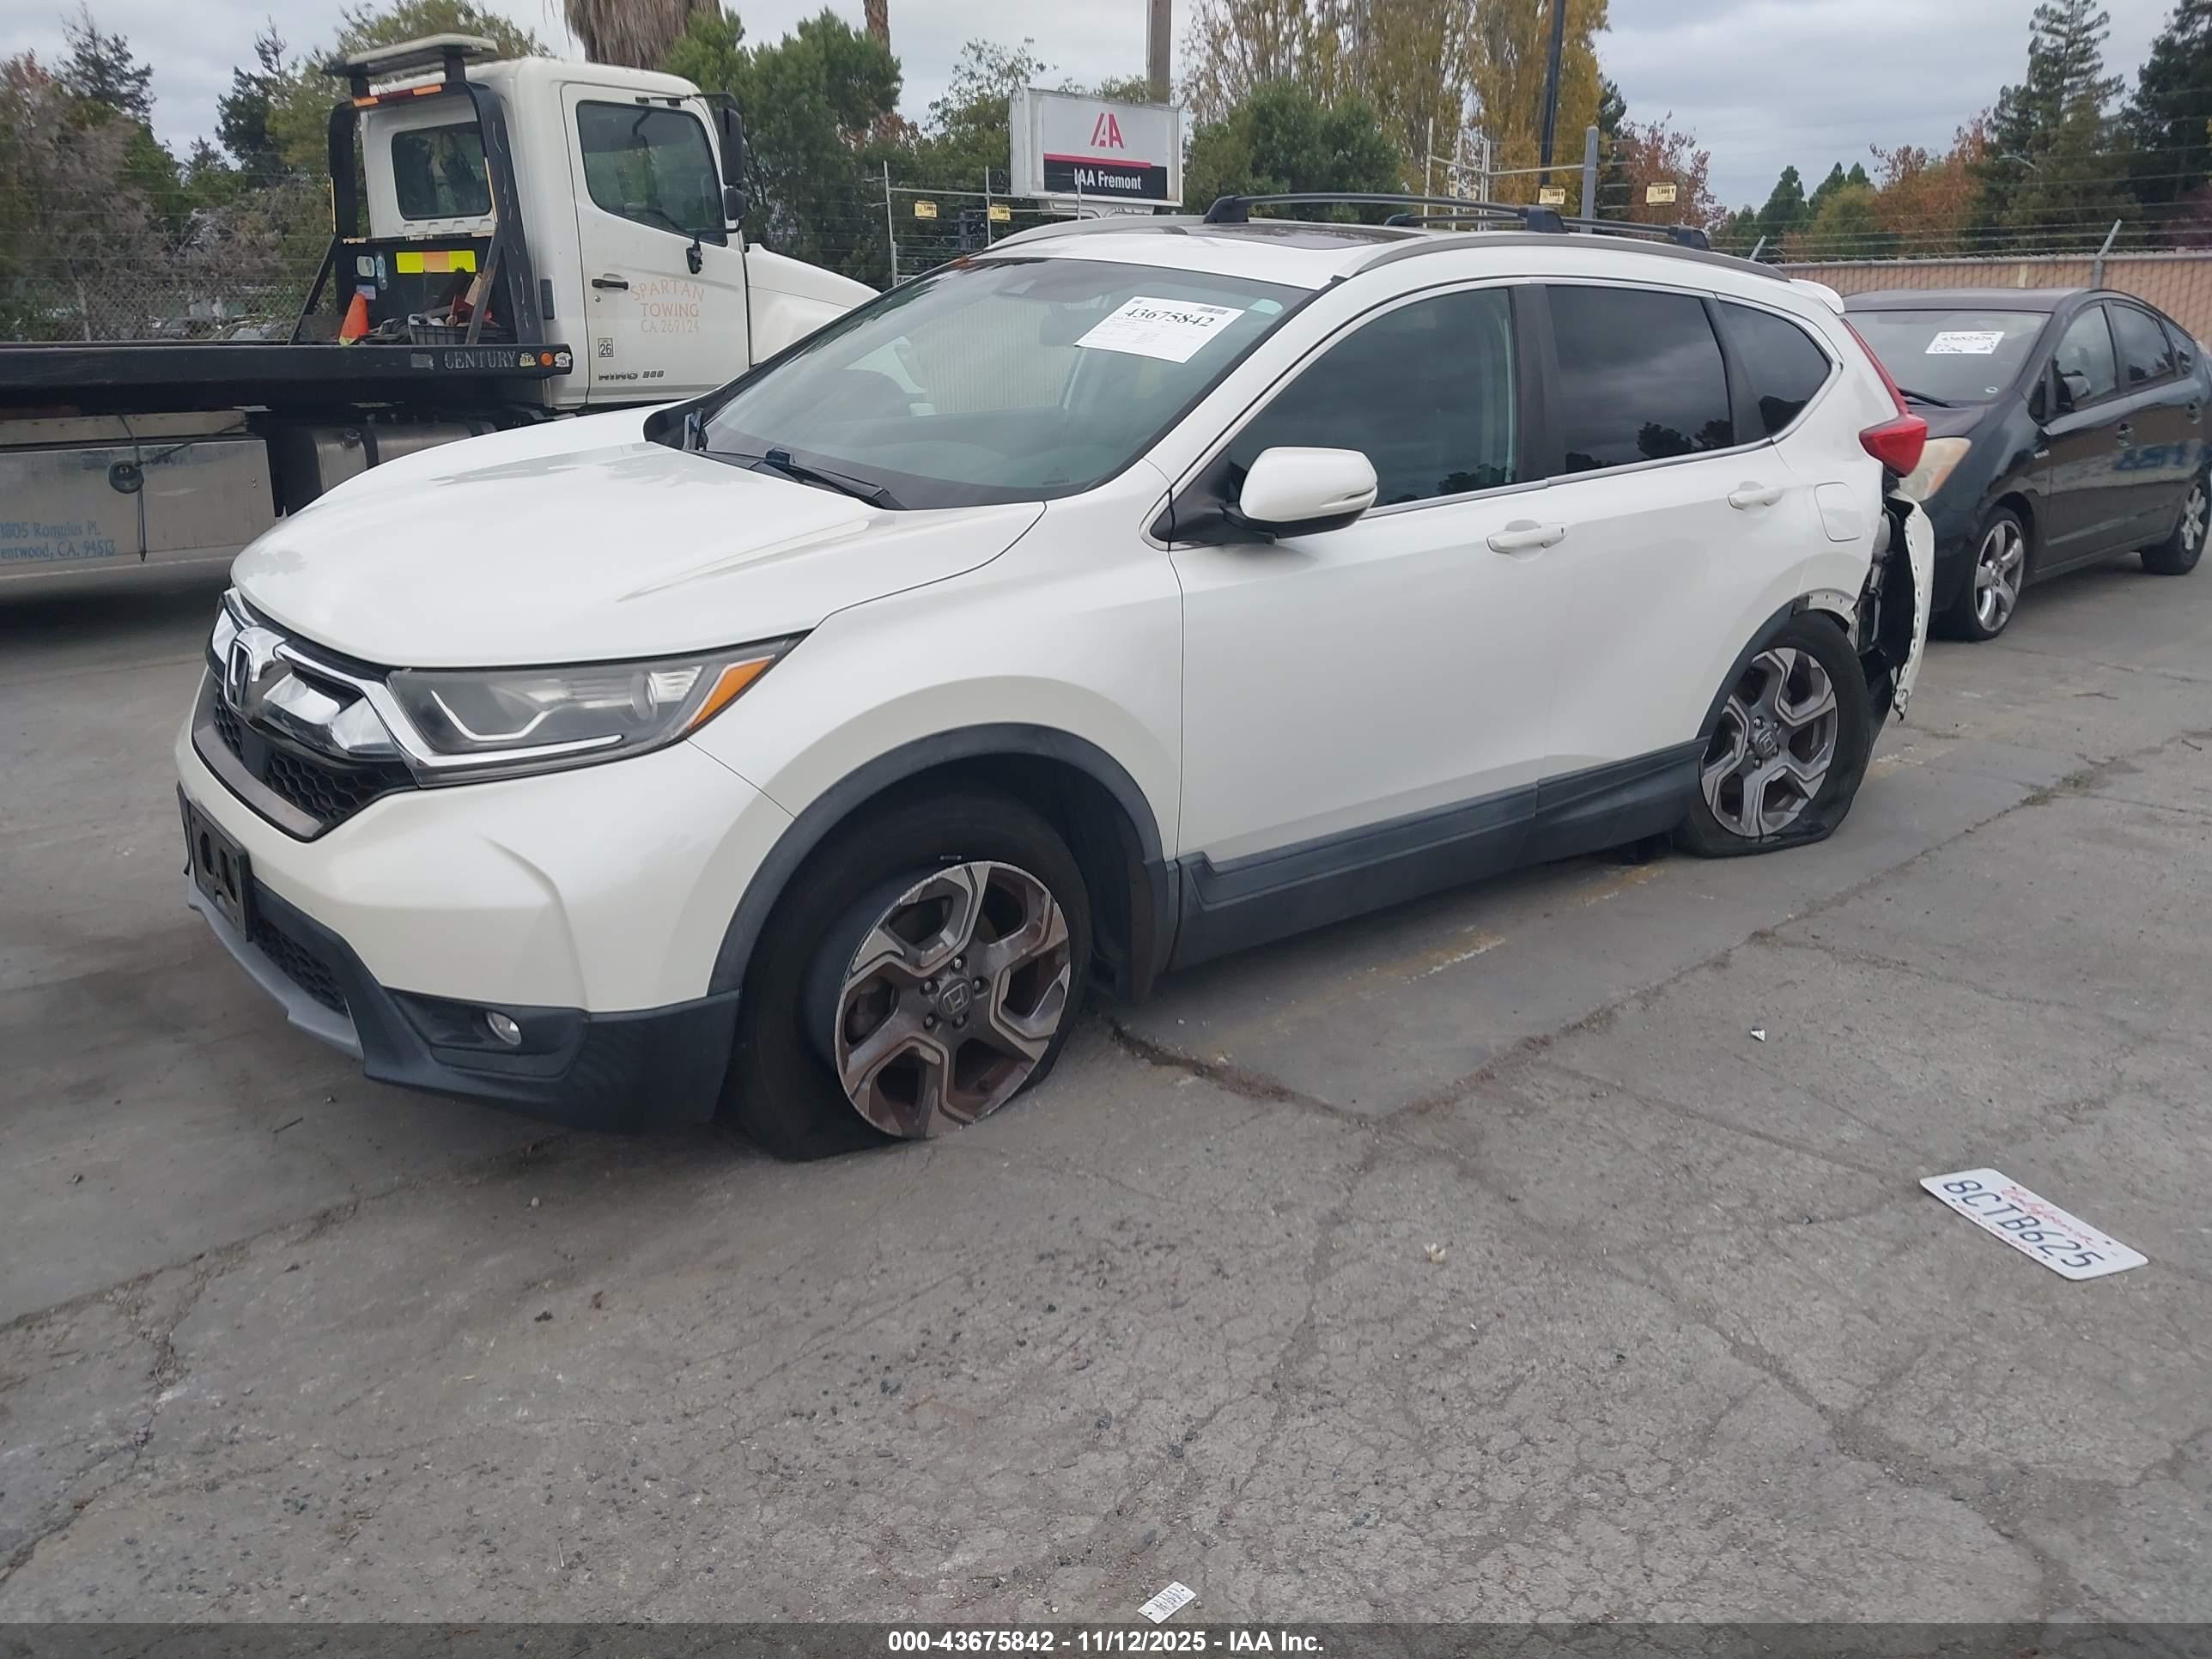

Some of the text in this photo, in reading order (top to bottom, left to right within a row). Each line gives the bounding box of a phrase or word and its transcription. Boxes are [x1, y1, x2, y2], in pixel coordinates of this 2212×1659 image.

[1074, 167, 1142, 191] IAA Fremont
[630, 278, 705, 302] SPARTAN
[641, 303, 700, 317] TOWING
[1123, 307, 1215, 328] 43675842
[641, 319, 659, 333] CA
[599, 343, 612, 356] 26
[445, 350, 516, 369] CENTURY
[33, 521, 83, 537] Romulus
[1942, 1180, 2106, 1268] 8CTB625
